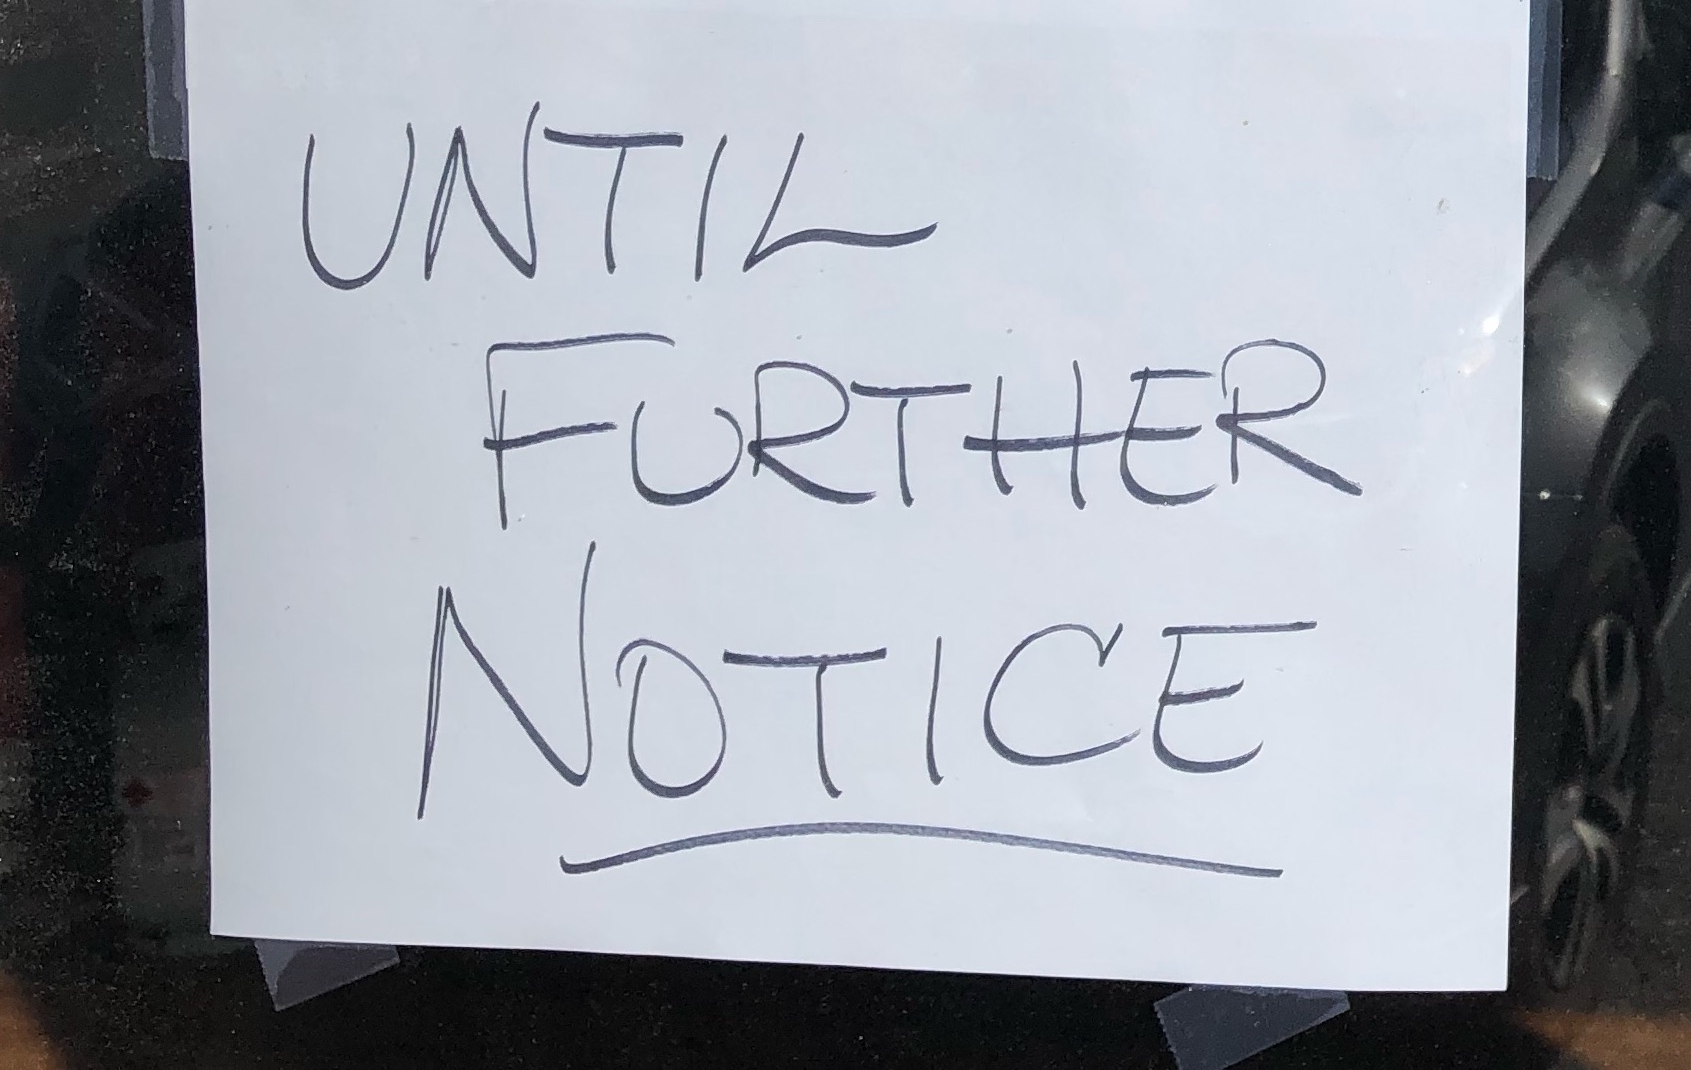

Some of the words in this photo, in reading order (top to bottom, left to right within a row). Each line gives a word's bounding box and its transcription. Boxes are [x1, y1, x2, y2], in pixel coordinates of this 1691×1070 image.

[302, 101, 938, 290] UNTIL
[483, 333, 1362, 530] FURTHER
[417, 541, 1317, 820] NOTICE
